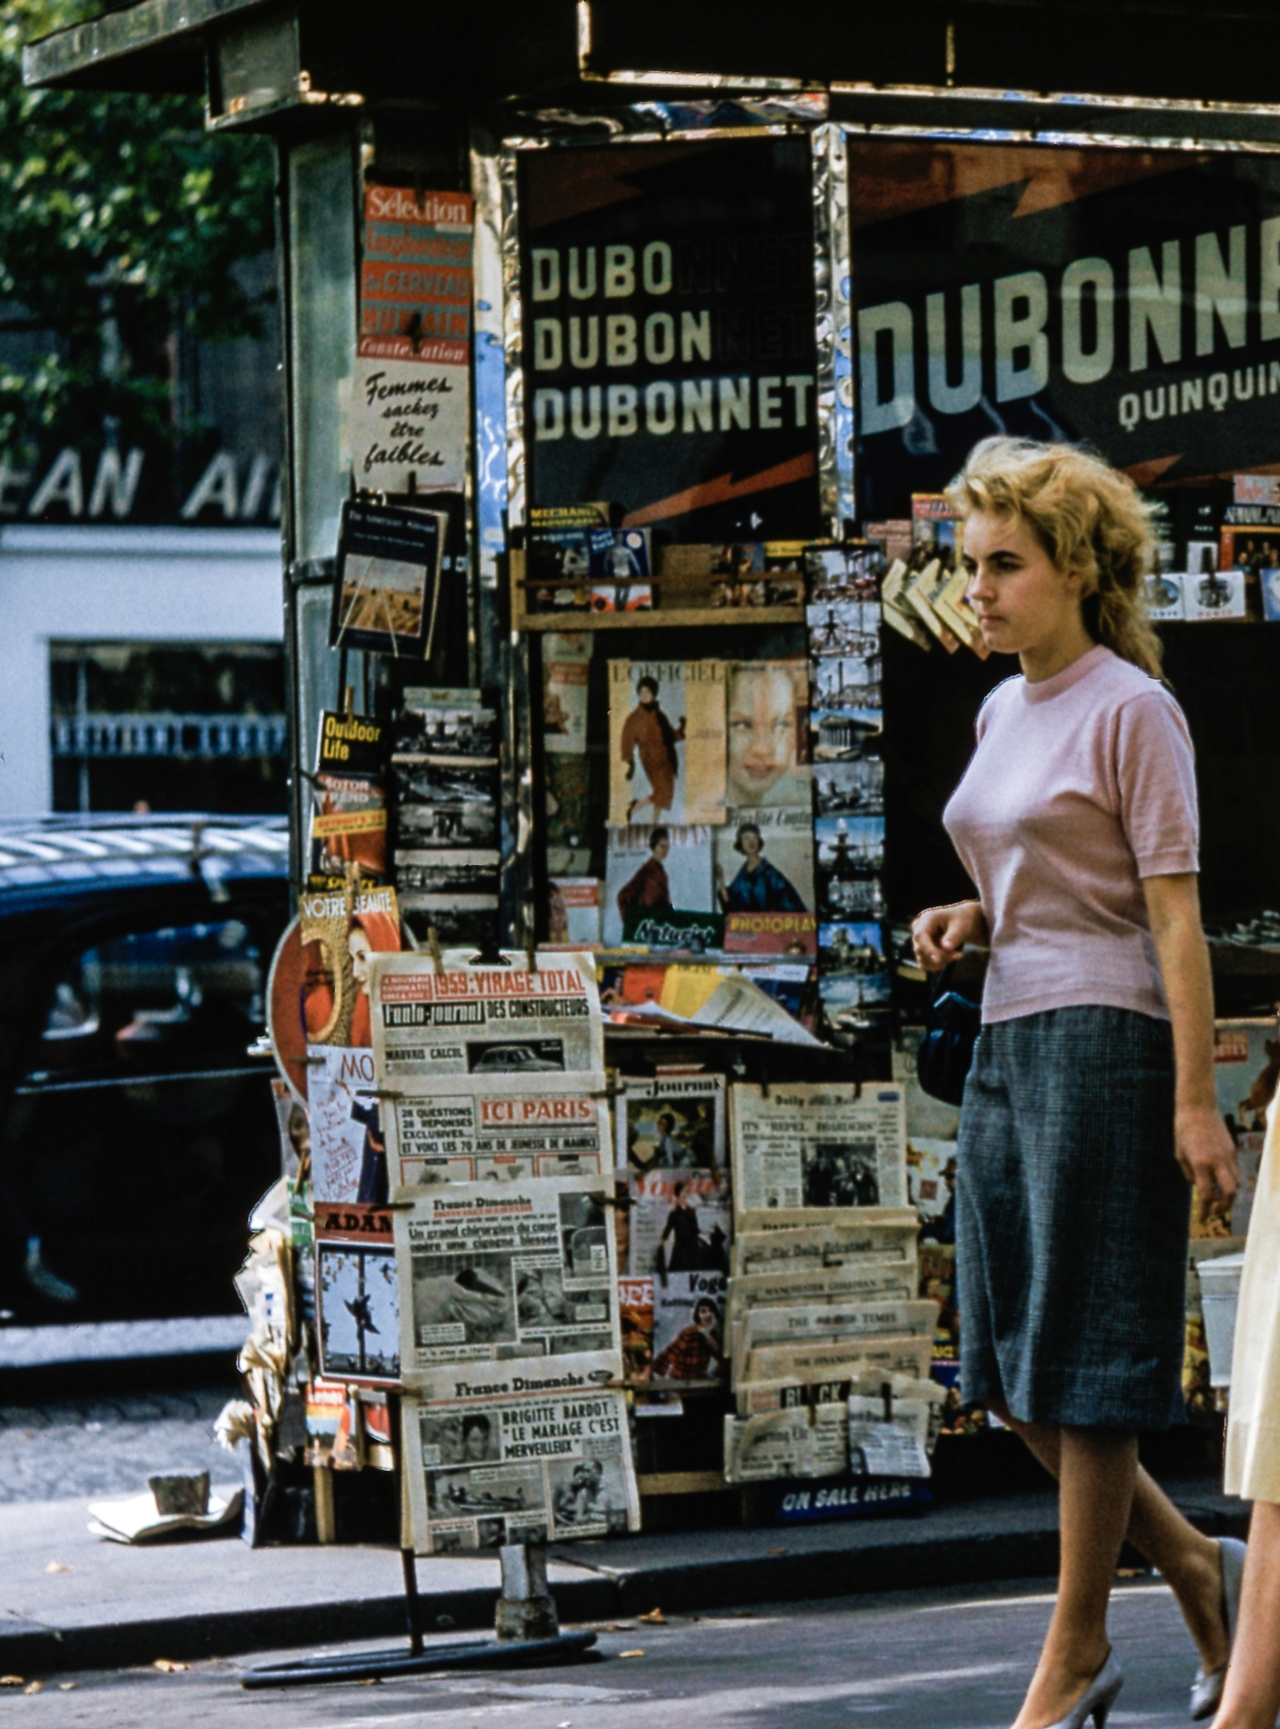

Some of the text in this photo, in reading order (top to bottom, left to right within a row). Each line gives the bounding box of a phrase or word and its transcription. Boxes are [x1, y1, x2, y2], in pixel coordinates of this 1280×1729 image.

[532, 241, 673, 301] DUBO
[534, 310, 711, 370] DUBON
[366, 371, 453, 405] Femmes
[534, 375, 814, 441] DUBONNET
[364, 440, 446, 473] faibles
[325, 717, 381, 743] Outdoor
[323, 738, 349, 760] Life
[303, 898, 346, 917] VOTRE
[474, 971, 535, 993] VIRAGE
[538, 970, 586, 993] TOTAL
[508, 998, 589, 1018] CONSTRUCTEURS
[385, 1047, 463, 1060] MAUVAIS CALCUL
[417, 1108, 473, 1118] QUESTIONS
[481, 1100, 591, 1120] ICI PARIS
[434, 1196, 532, 1210] France Dimanche
[409, 1228, 424, 1239] Un
[427, 1225, 458, 1240] grand
[518, 1222, 530, 1232] du
[788, 1312, 897, 1328] THE TIMES
[455, 1373, 585, 1397] France Dimanche
[502, 1407, 555, 1426] BRIGITTE
[563, 1402, 608, 1420] BARDOT
[531, 1421, 582, 1440] MARIAGE
[588, 1417, 620, 1434] C'EST
[782, 1493, 811, 1512] ON
[815, 1487, 858, 1508] SALE
